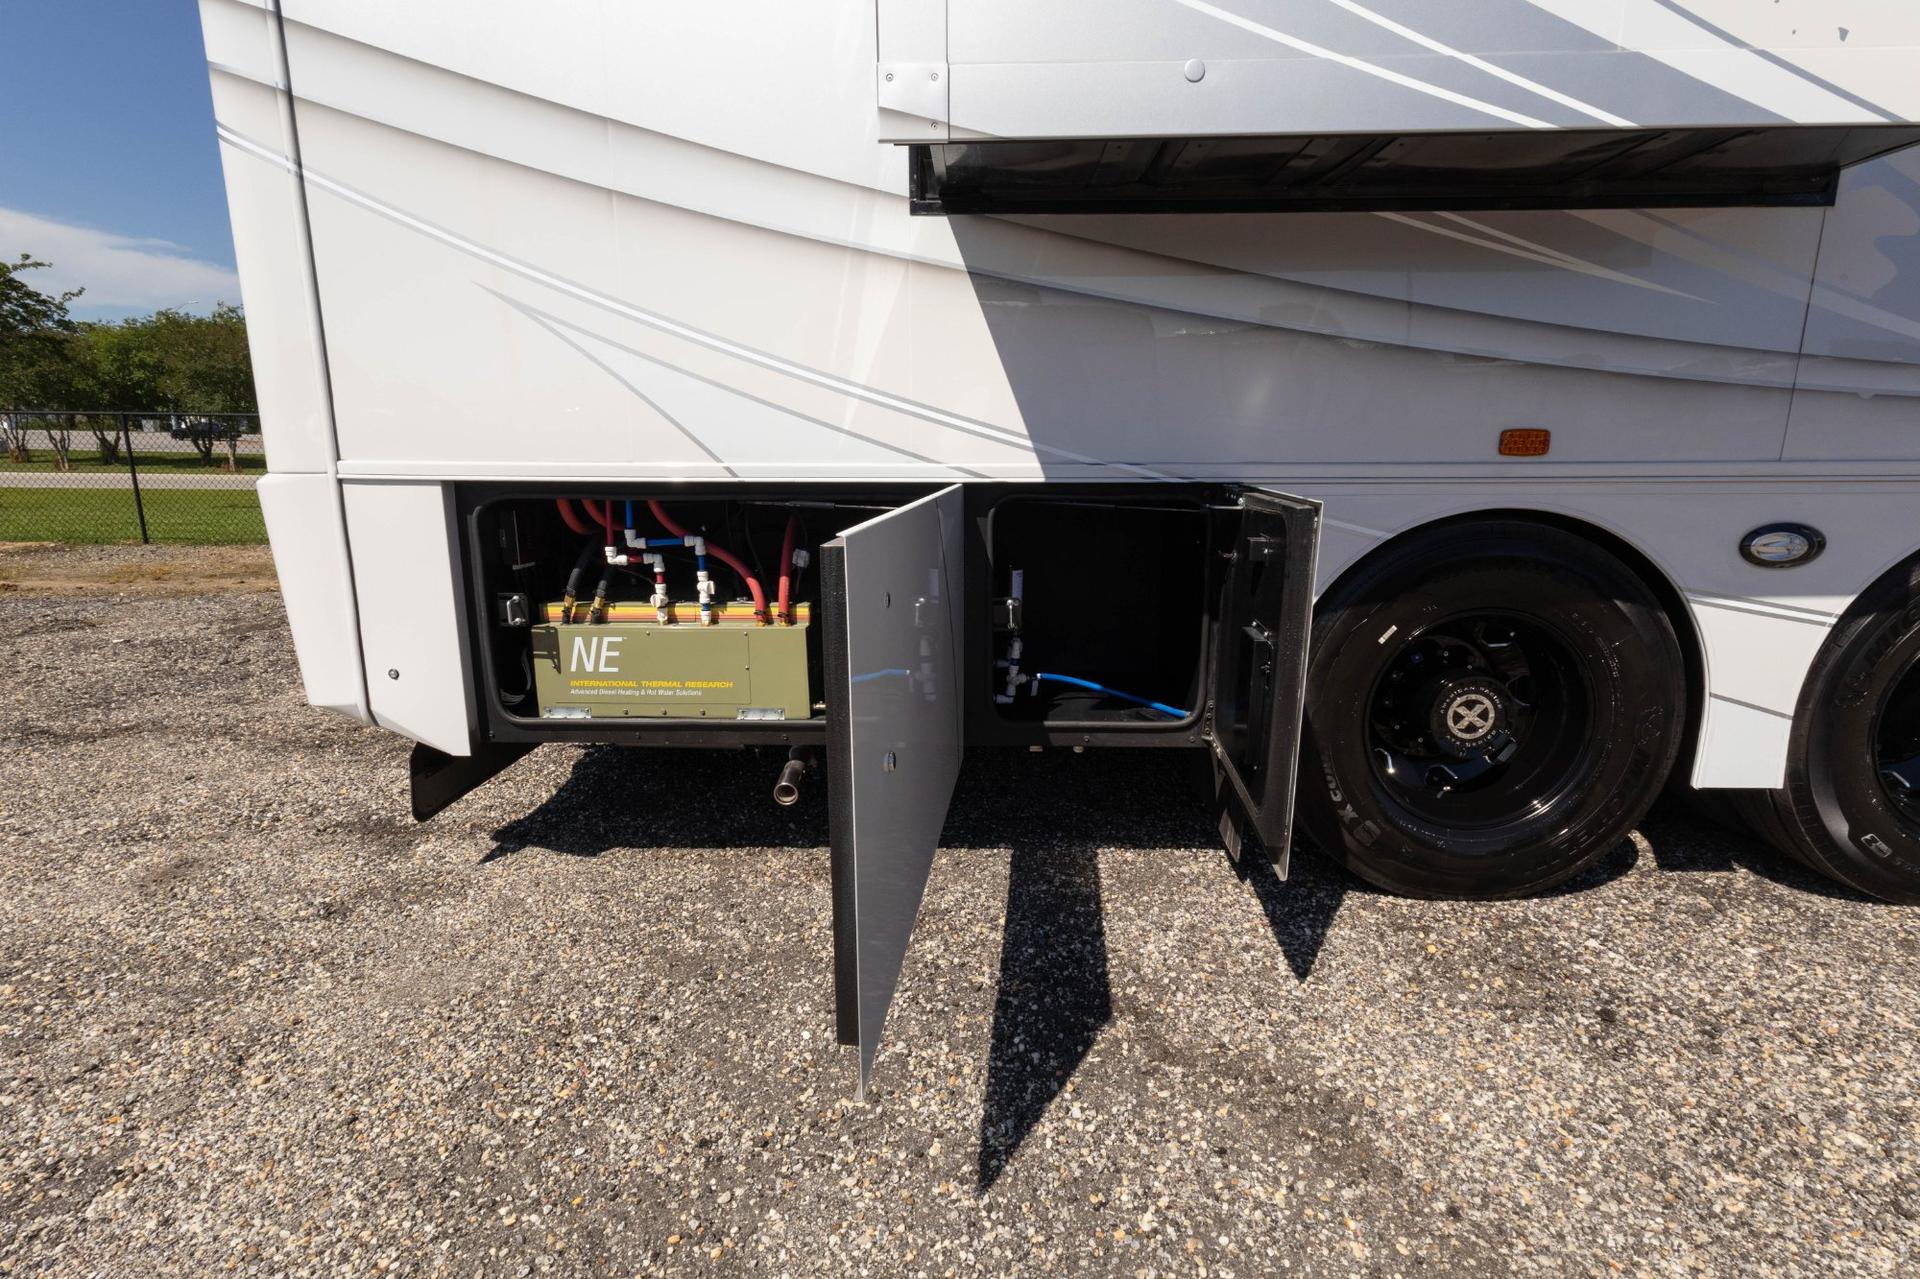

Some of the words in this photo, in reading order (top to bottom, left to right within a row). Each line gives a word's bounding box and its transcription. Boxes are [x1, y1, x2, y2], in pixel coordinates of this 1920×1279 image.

[570, 636, 623, 673] NE
[570, 680, 638, 688] INTERNATIONAL
[641, 680, 682, 688] THERMAL
[684, 681, 733, 689] RESEARCH
[618, 689, 640, 697] Heating
